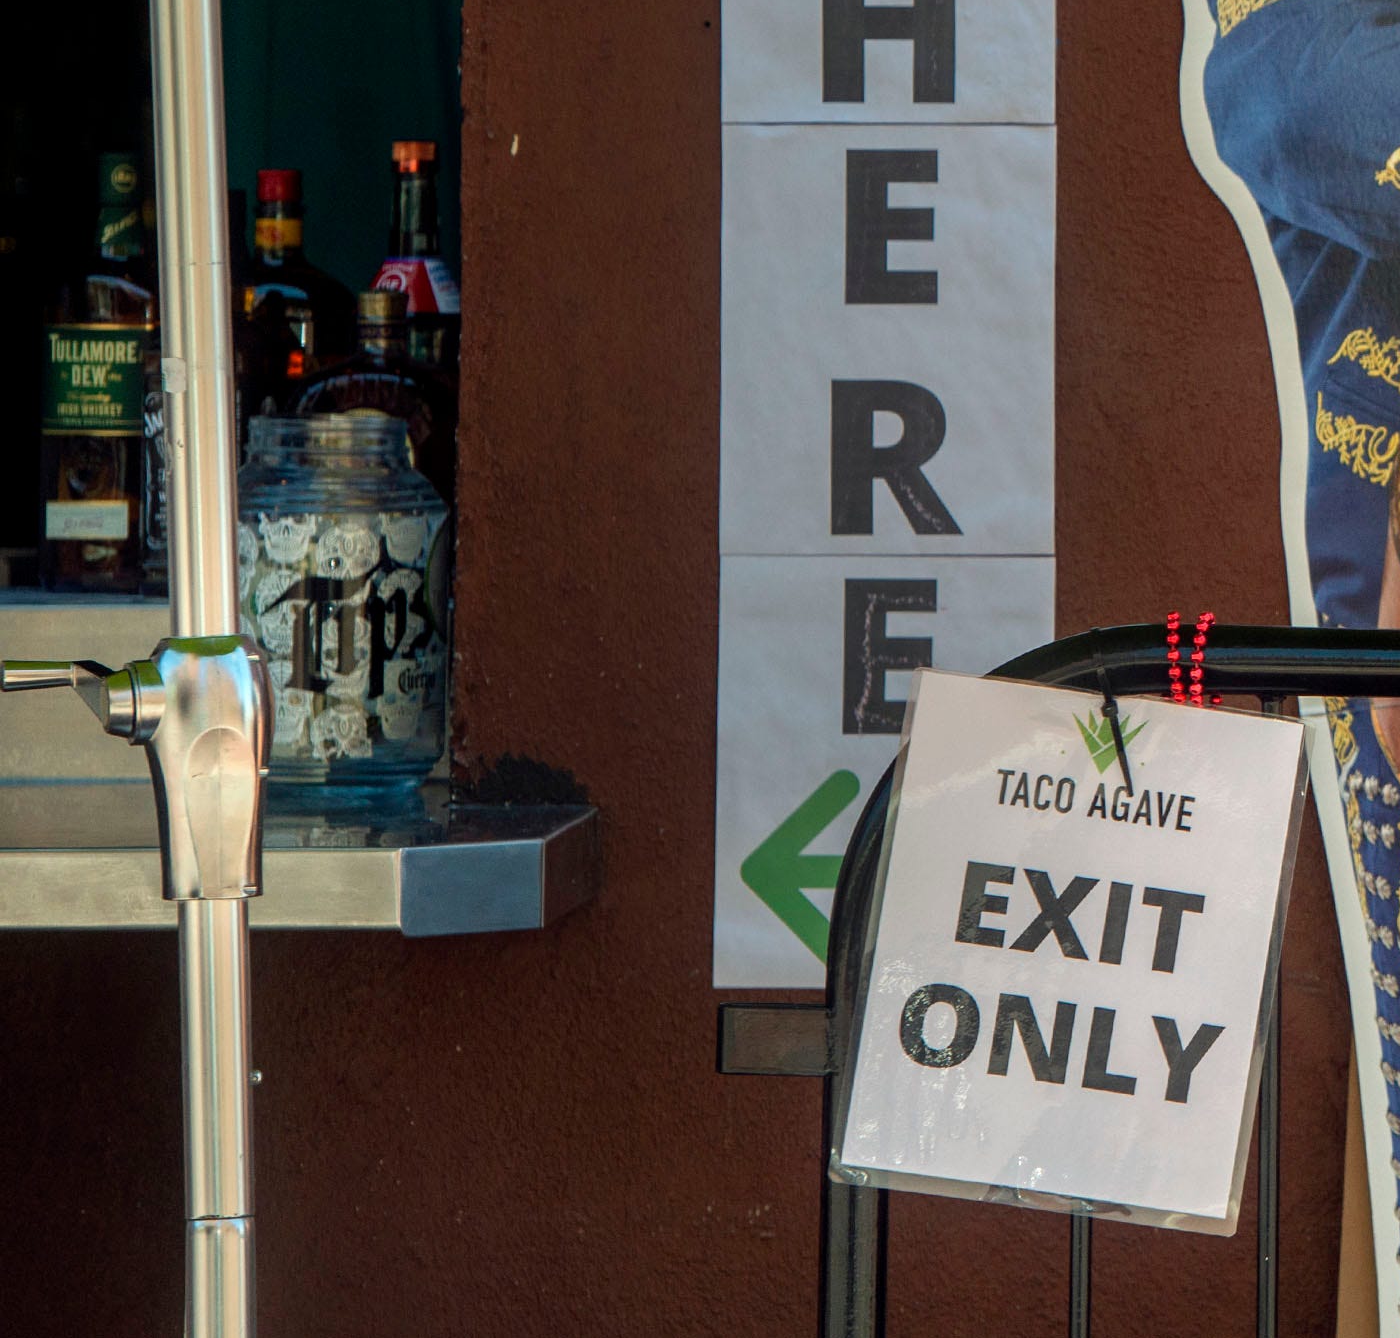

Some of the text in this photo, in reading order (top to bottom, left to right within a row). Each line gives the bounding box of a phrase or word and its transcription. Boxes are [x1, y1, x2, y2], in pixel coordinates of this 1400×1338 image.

[49, 333, 138, 364] TULLAMORE
[996, 768, 1196, 833] TACO AGAVE
[954, 860, 1206, 975] EXIT
[898, 982, 1227, 1104] ONLY
